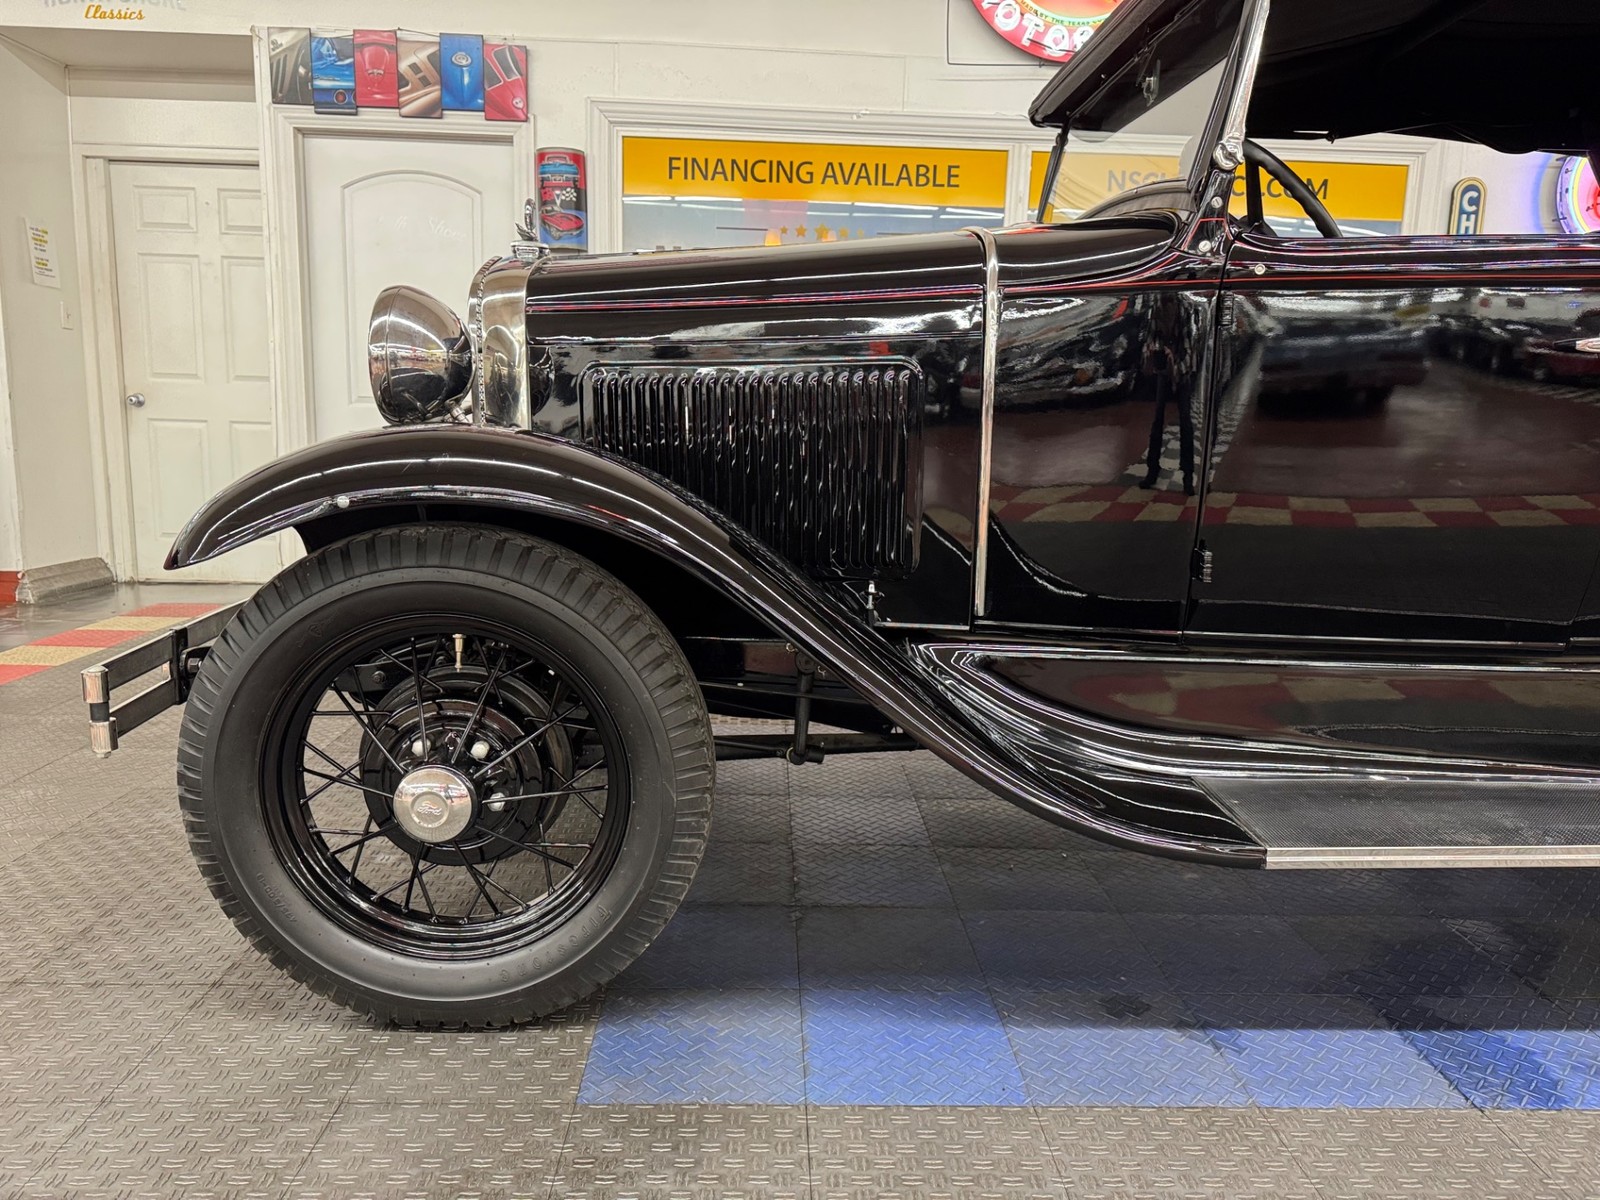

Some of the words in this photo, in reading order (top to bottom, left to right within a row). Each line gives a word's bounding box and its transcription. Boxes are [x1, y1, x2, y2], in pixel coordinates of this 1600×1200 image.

[84, 4, 146, 21] Classics
[668, 156, 814, 185] FINANCING
[821, 161, 961, 189] AVAILABLE
[417, 800, 442, 816] Ford
